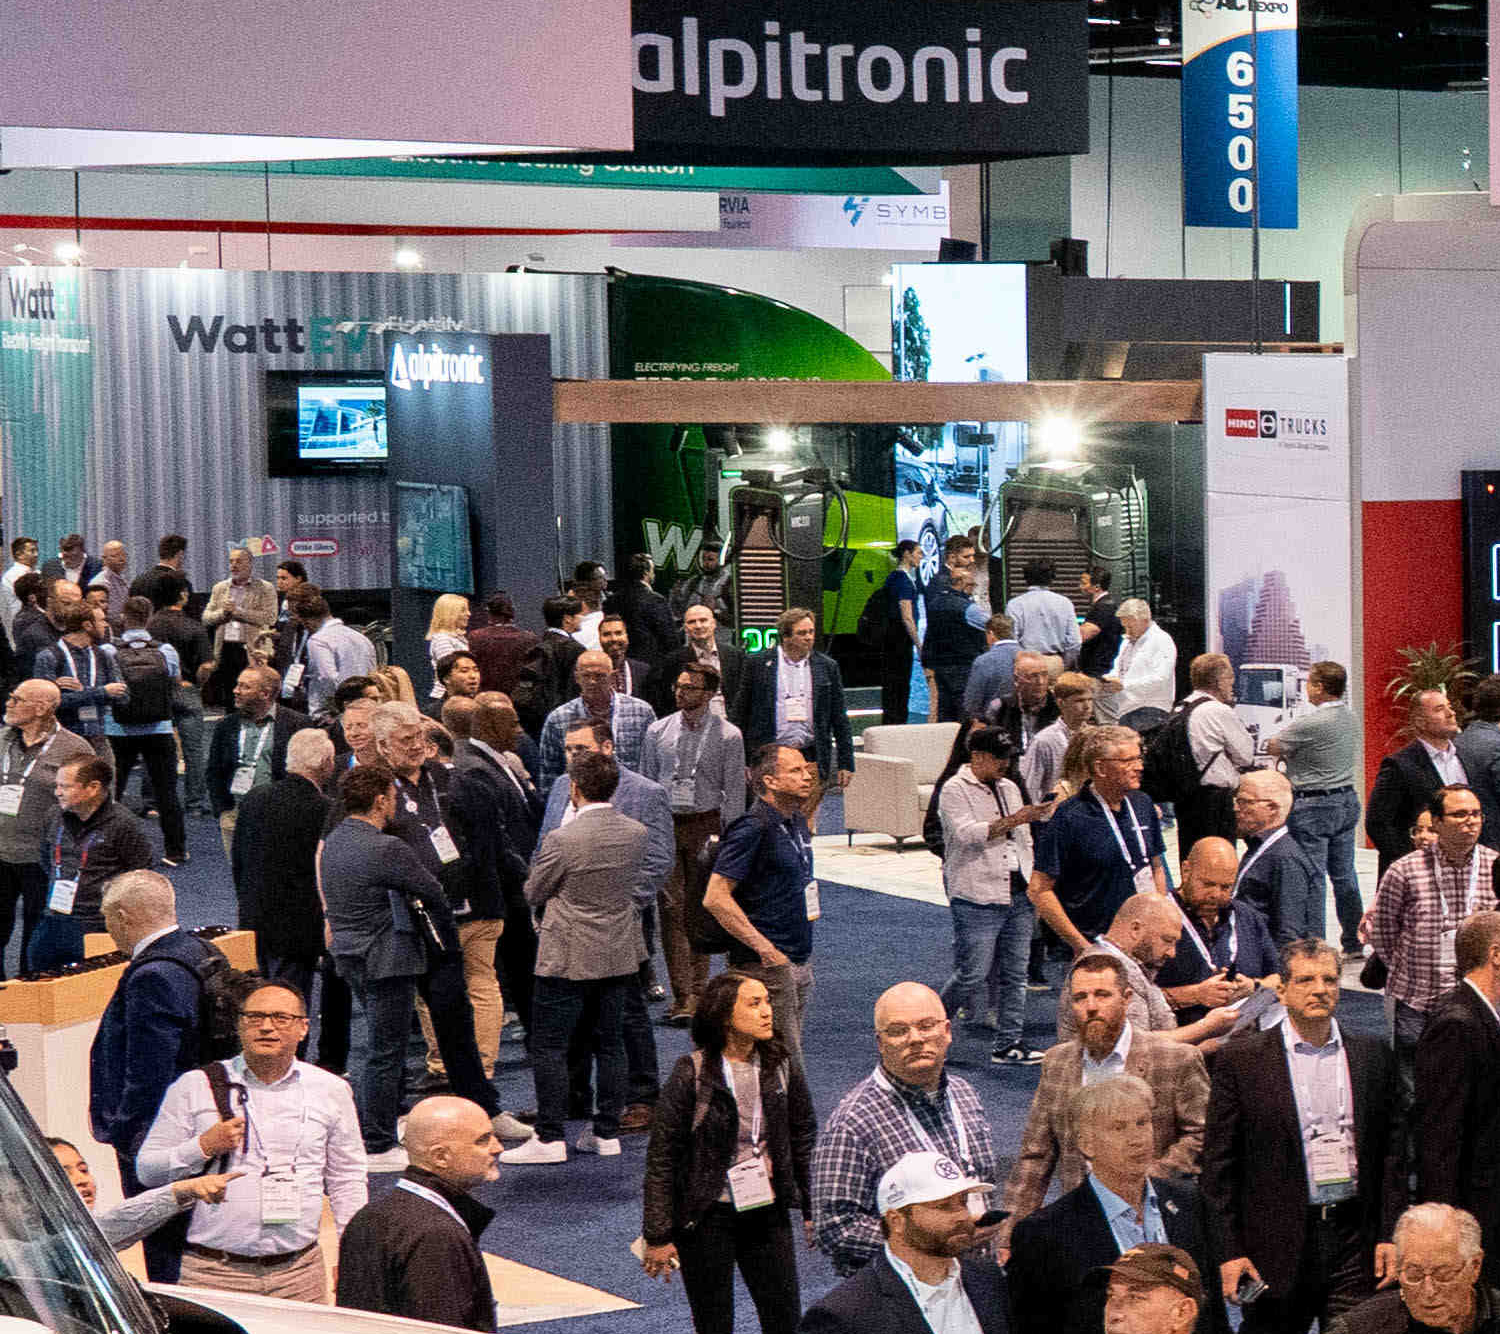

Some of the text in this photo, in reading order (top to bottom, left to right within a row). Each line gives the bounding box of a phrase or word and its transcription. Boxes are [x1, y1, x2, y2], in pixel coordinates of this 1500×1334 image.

[632, 16, 1029, 117] alpitronic
[1226, 50, 1254, 213] 6500
[1228, 417, 1327, 436] HINO TRUCKS
